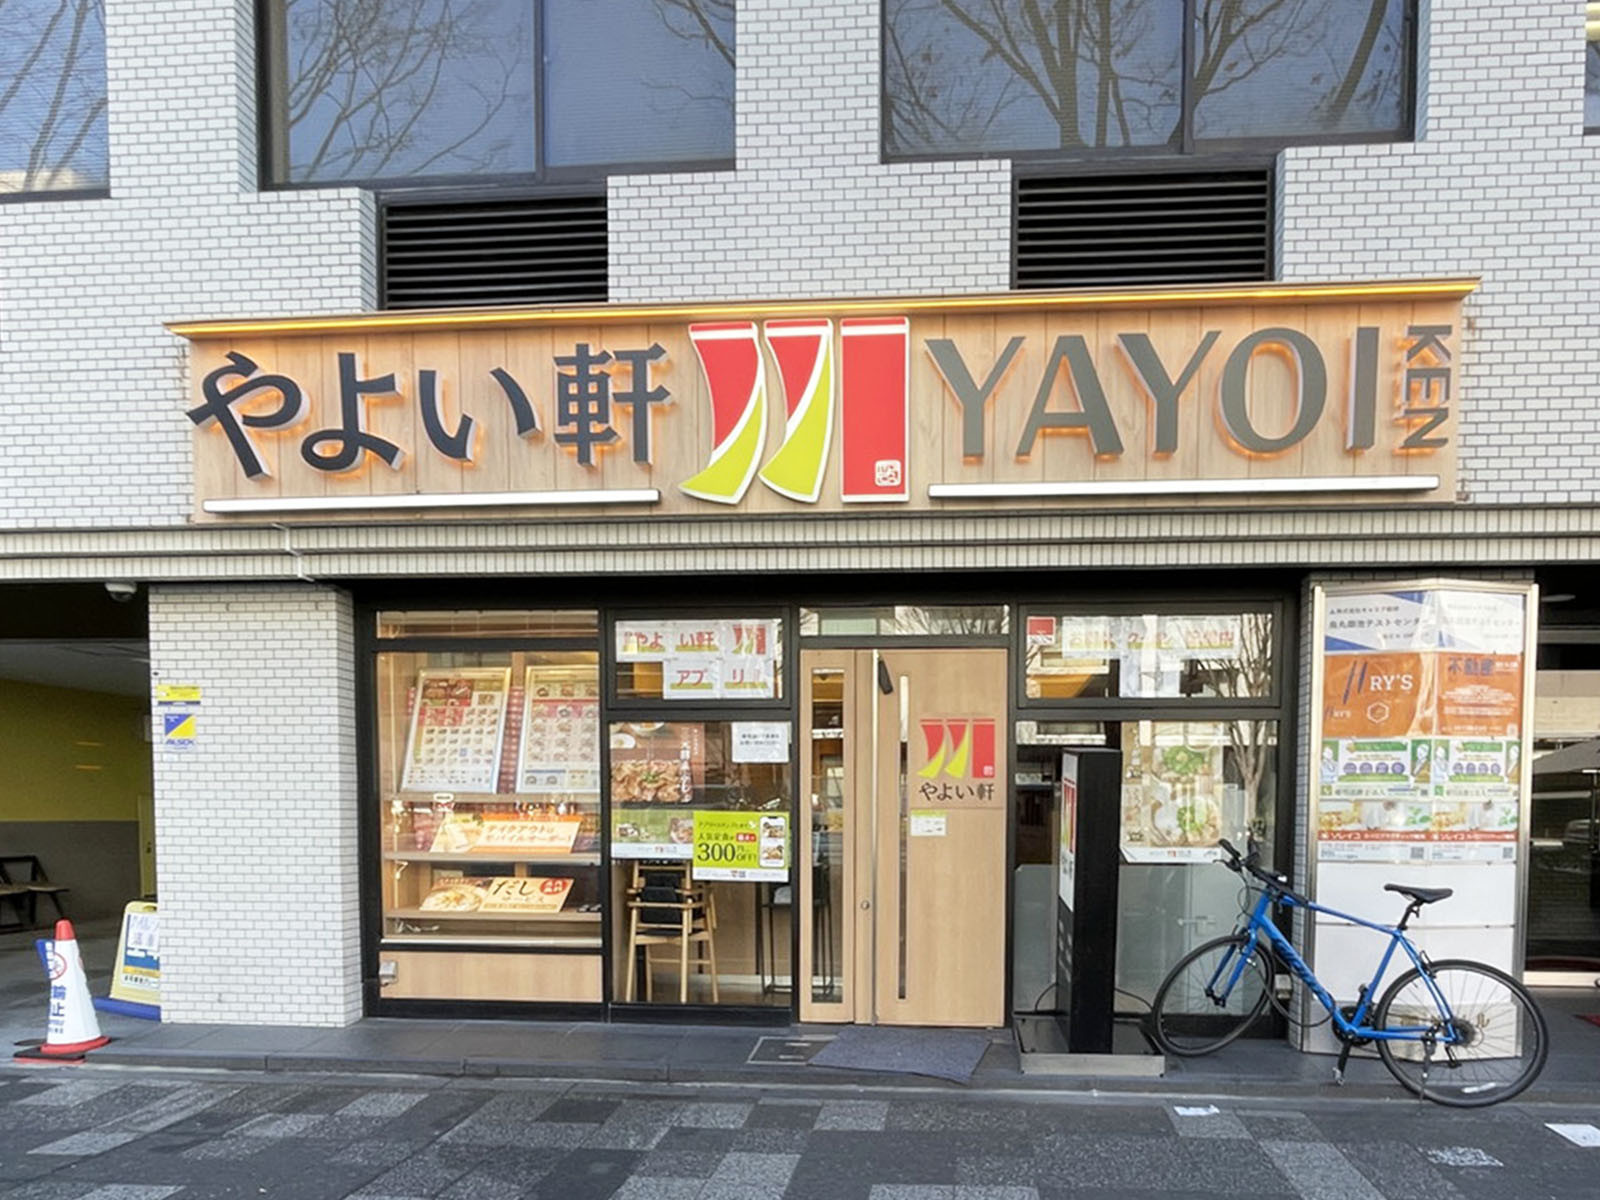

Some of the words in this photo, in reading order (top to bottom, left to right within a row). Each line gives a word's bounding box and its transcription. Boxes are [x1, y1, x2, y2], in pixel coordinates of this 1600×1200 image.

[186, 343, 673, 479] やよい軒
[924, 327, 1380, 458] YAYOI
[1403, 324, 1453, 449] KEN
[1369, 673, 1414, 692] RY'S
[918, 782, 995, 801] やよい軒
